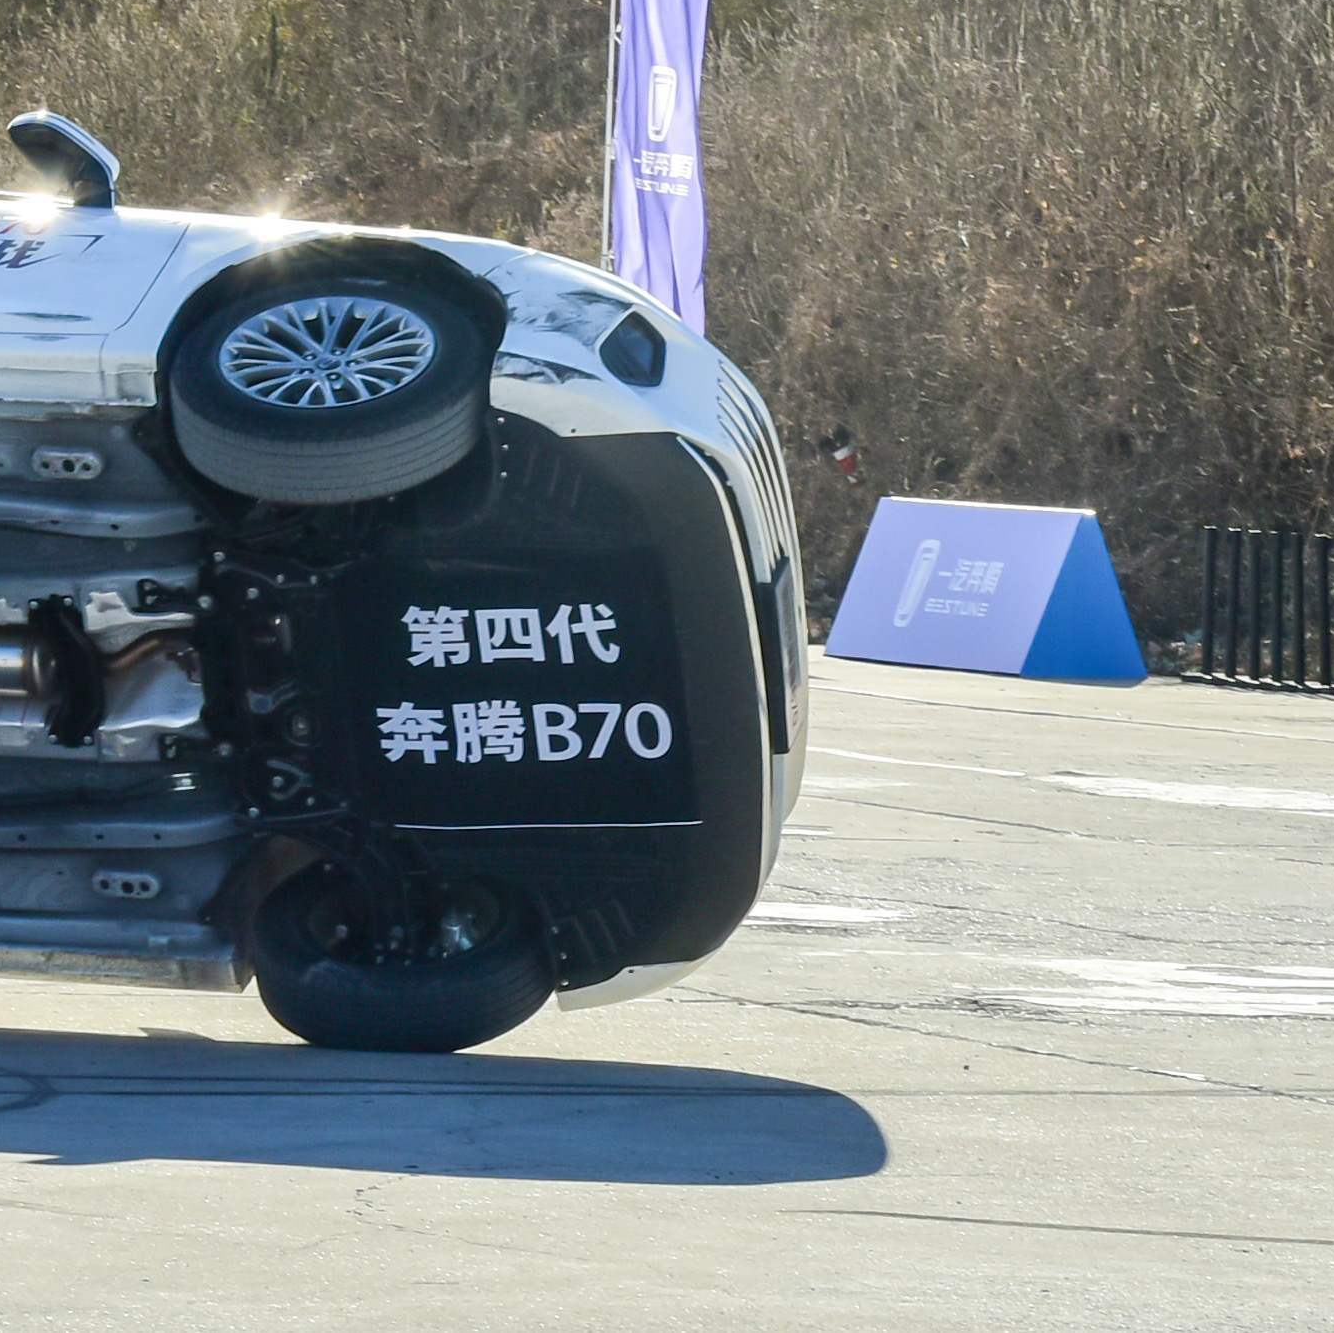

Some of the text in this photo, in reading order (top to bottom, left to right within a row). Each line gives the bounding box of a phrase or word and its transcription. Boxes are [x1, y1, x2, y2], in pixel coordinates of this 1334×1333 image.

[400, 604, 621, 667] 第四代
[375, 700, 673, 764] 奔腾B70
